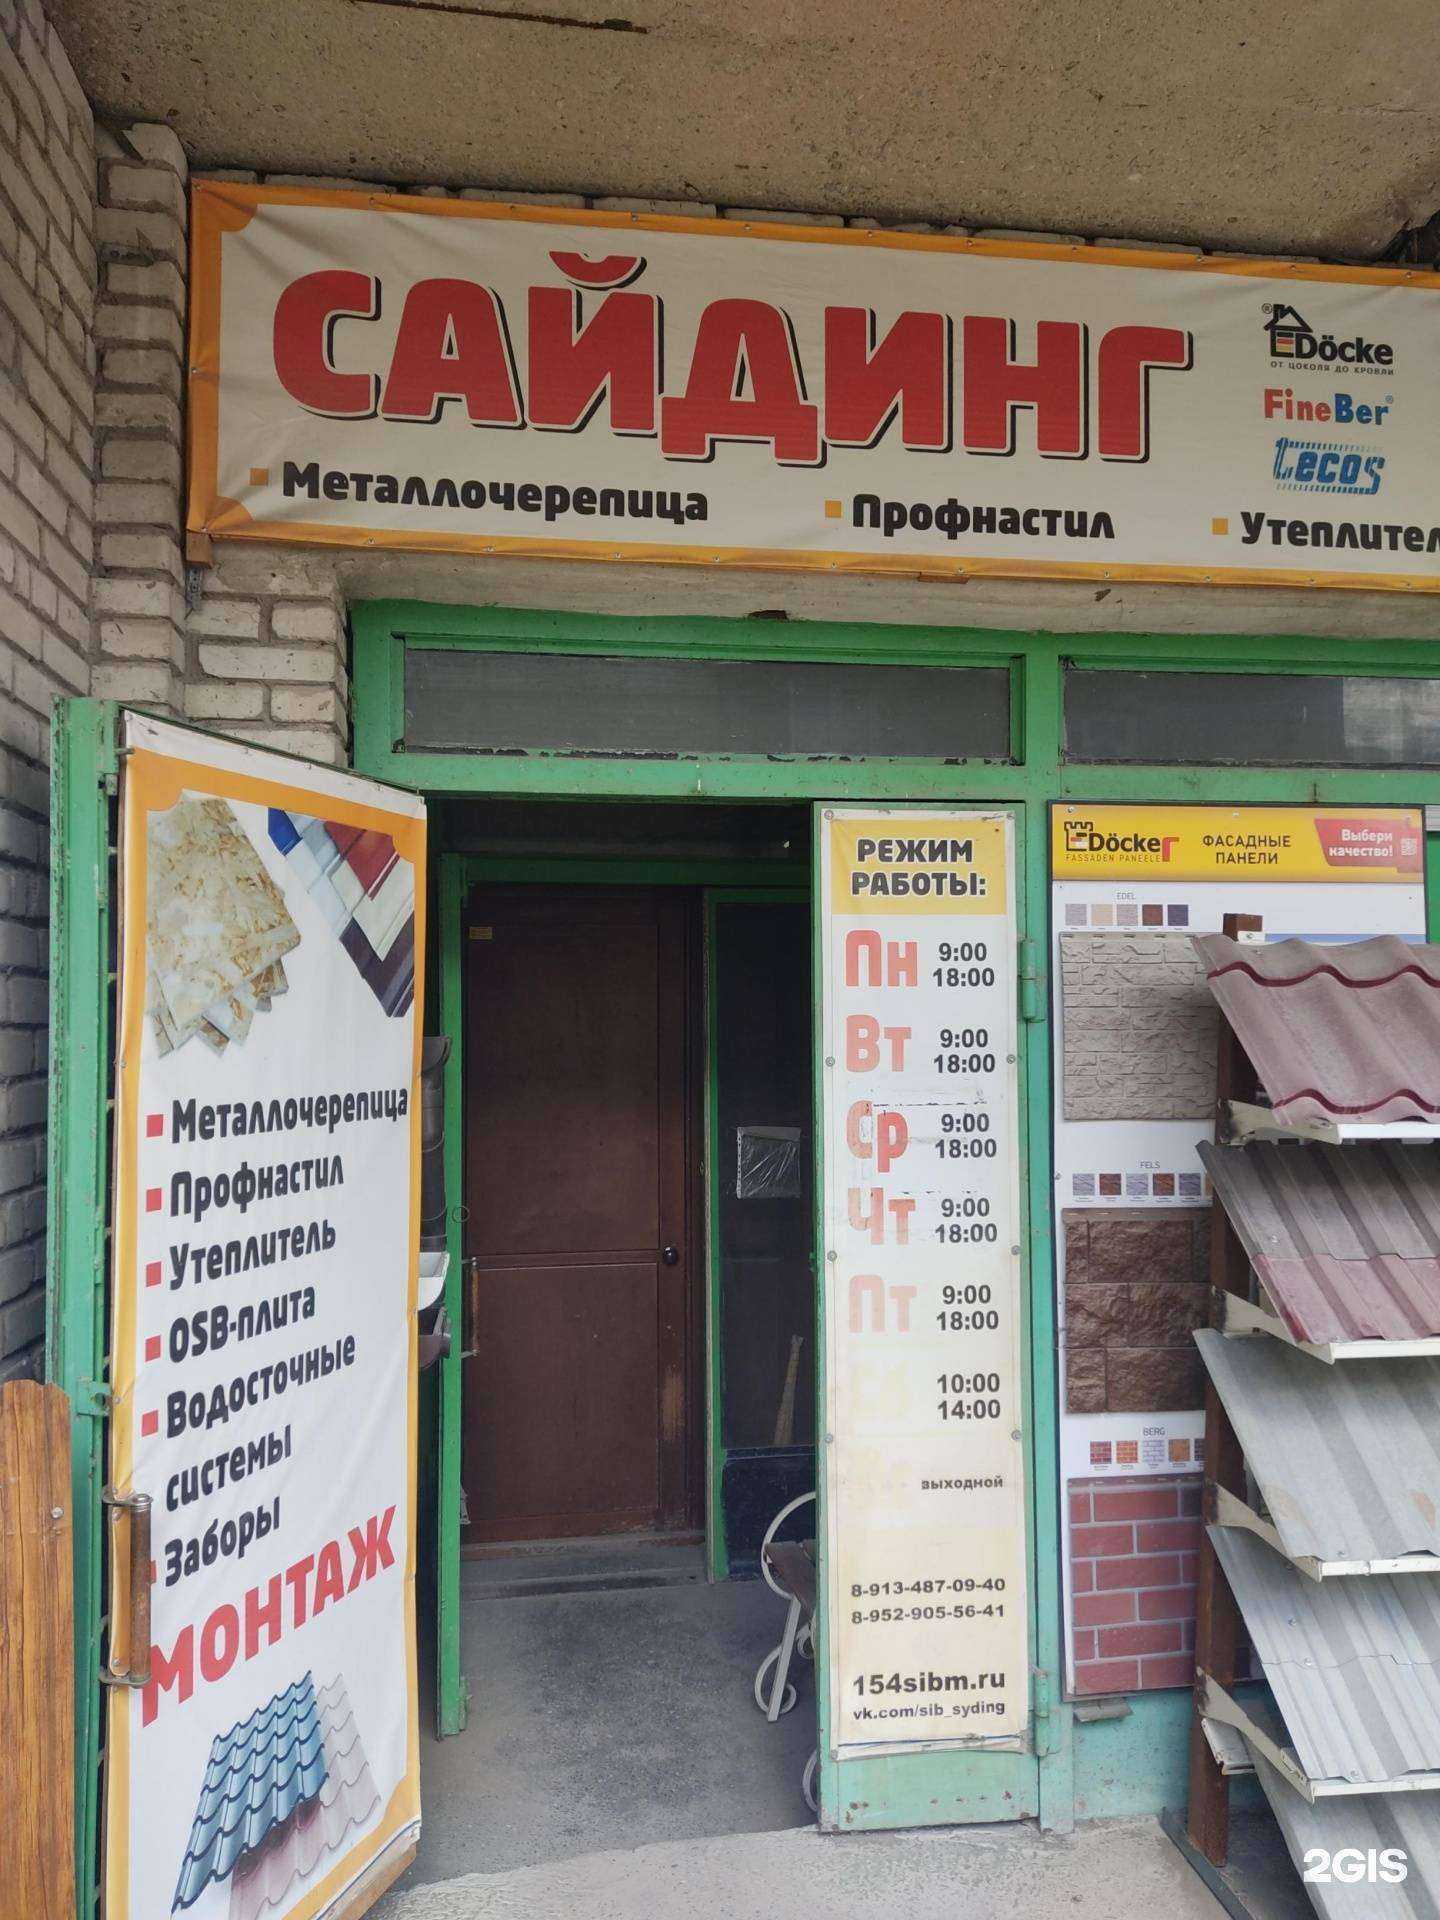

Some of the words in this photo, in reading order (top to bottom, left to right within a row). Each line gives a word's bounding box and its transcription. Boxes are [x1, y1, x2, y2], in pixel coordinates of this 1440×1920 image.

[273, 250, 1194, 467] САЙДИНГ
[1294, 334, 1394, 365] Döcke
[1270, 361, 1283, 369] ОТ
[1288, 362, 1330, 372] ЦОКОЛЯ
[1335, 365, 1349, 374] ДО
[1354, 367, 1394, 376] КРОВЛИ
[1264, 388, 1389, 425] FineBer
[282, 461, 708, 525] Металлочерепица
[852, 494, 1115, 540] Профнастил
[1202, 834, 1292, 849] ФАСАДНЫЕ
[1341, 828, 1393, 844] Выбери
[857, 838, 973, 863] РЕЖИМ
[1065, 854, 1115, 862] FASSADEN
[1215, 852, 1279, 865] ПАНЕЛИ
[1328, 845, 1394, 857] качество!
[851, 872, 986, 896] РАБОТЫ:
[845, 929, 918, 987] Пн
[938, 942, 987, 962] 9:00
[933, 967, 995, 987] 18:00
[846, 1014, 912, 1073] Вт
[940, 1029, 988, 1048] 9:00
[933, 1054, 996, 1074] 18:00
[171, 1088, 409, 1144] Металлочерепица
[941, 1113, 990, 1133] 9:00
[846, 1100, 908, 1173] Ср
[935, 1139, 997, 1159] 18:00
[170, 1154, 344, 1223] Профнастил
[847, 1187, 916, 1245] Чт
[941, 1198, 990, 1217] 9:00
[935, 1223, 997, 1243] 18:00
[169, 1219, 337, 1291] Утеплитель
[849, 1274, 917, 1333] Пт
[942, 1285, 991, 1304] 9:00
[168, 1286, 315, 1363] OSB-плита
[936, 1310, 999, 1331] 18:00
[166, 1334, 356, 1438] Водосточные
[936, 1373, 1001, 1394] 10:00
[936, 1399, 1001, 1420] 14:00
[166, 1424, 291, 1512] системы
[921, 1475, 1004, 1491] выходной
[165, 1496, 280, 1587] Заборы
[851, 1577, 1006, 1598] 8-913-487-09-40
[141, 1504, 397, 1729] МОНТАЖ
[851, 1604, 1006, 1625] 8-952-905-56-41
[852, 1671, 1006, 1696] 154sibm.ru
[853, 1701, 1006, 1720] vk.com/sib_syding
